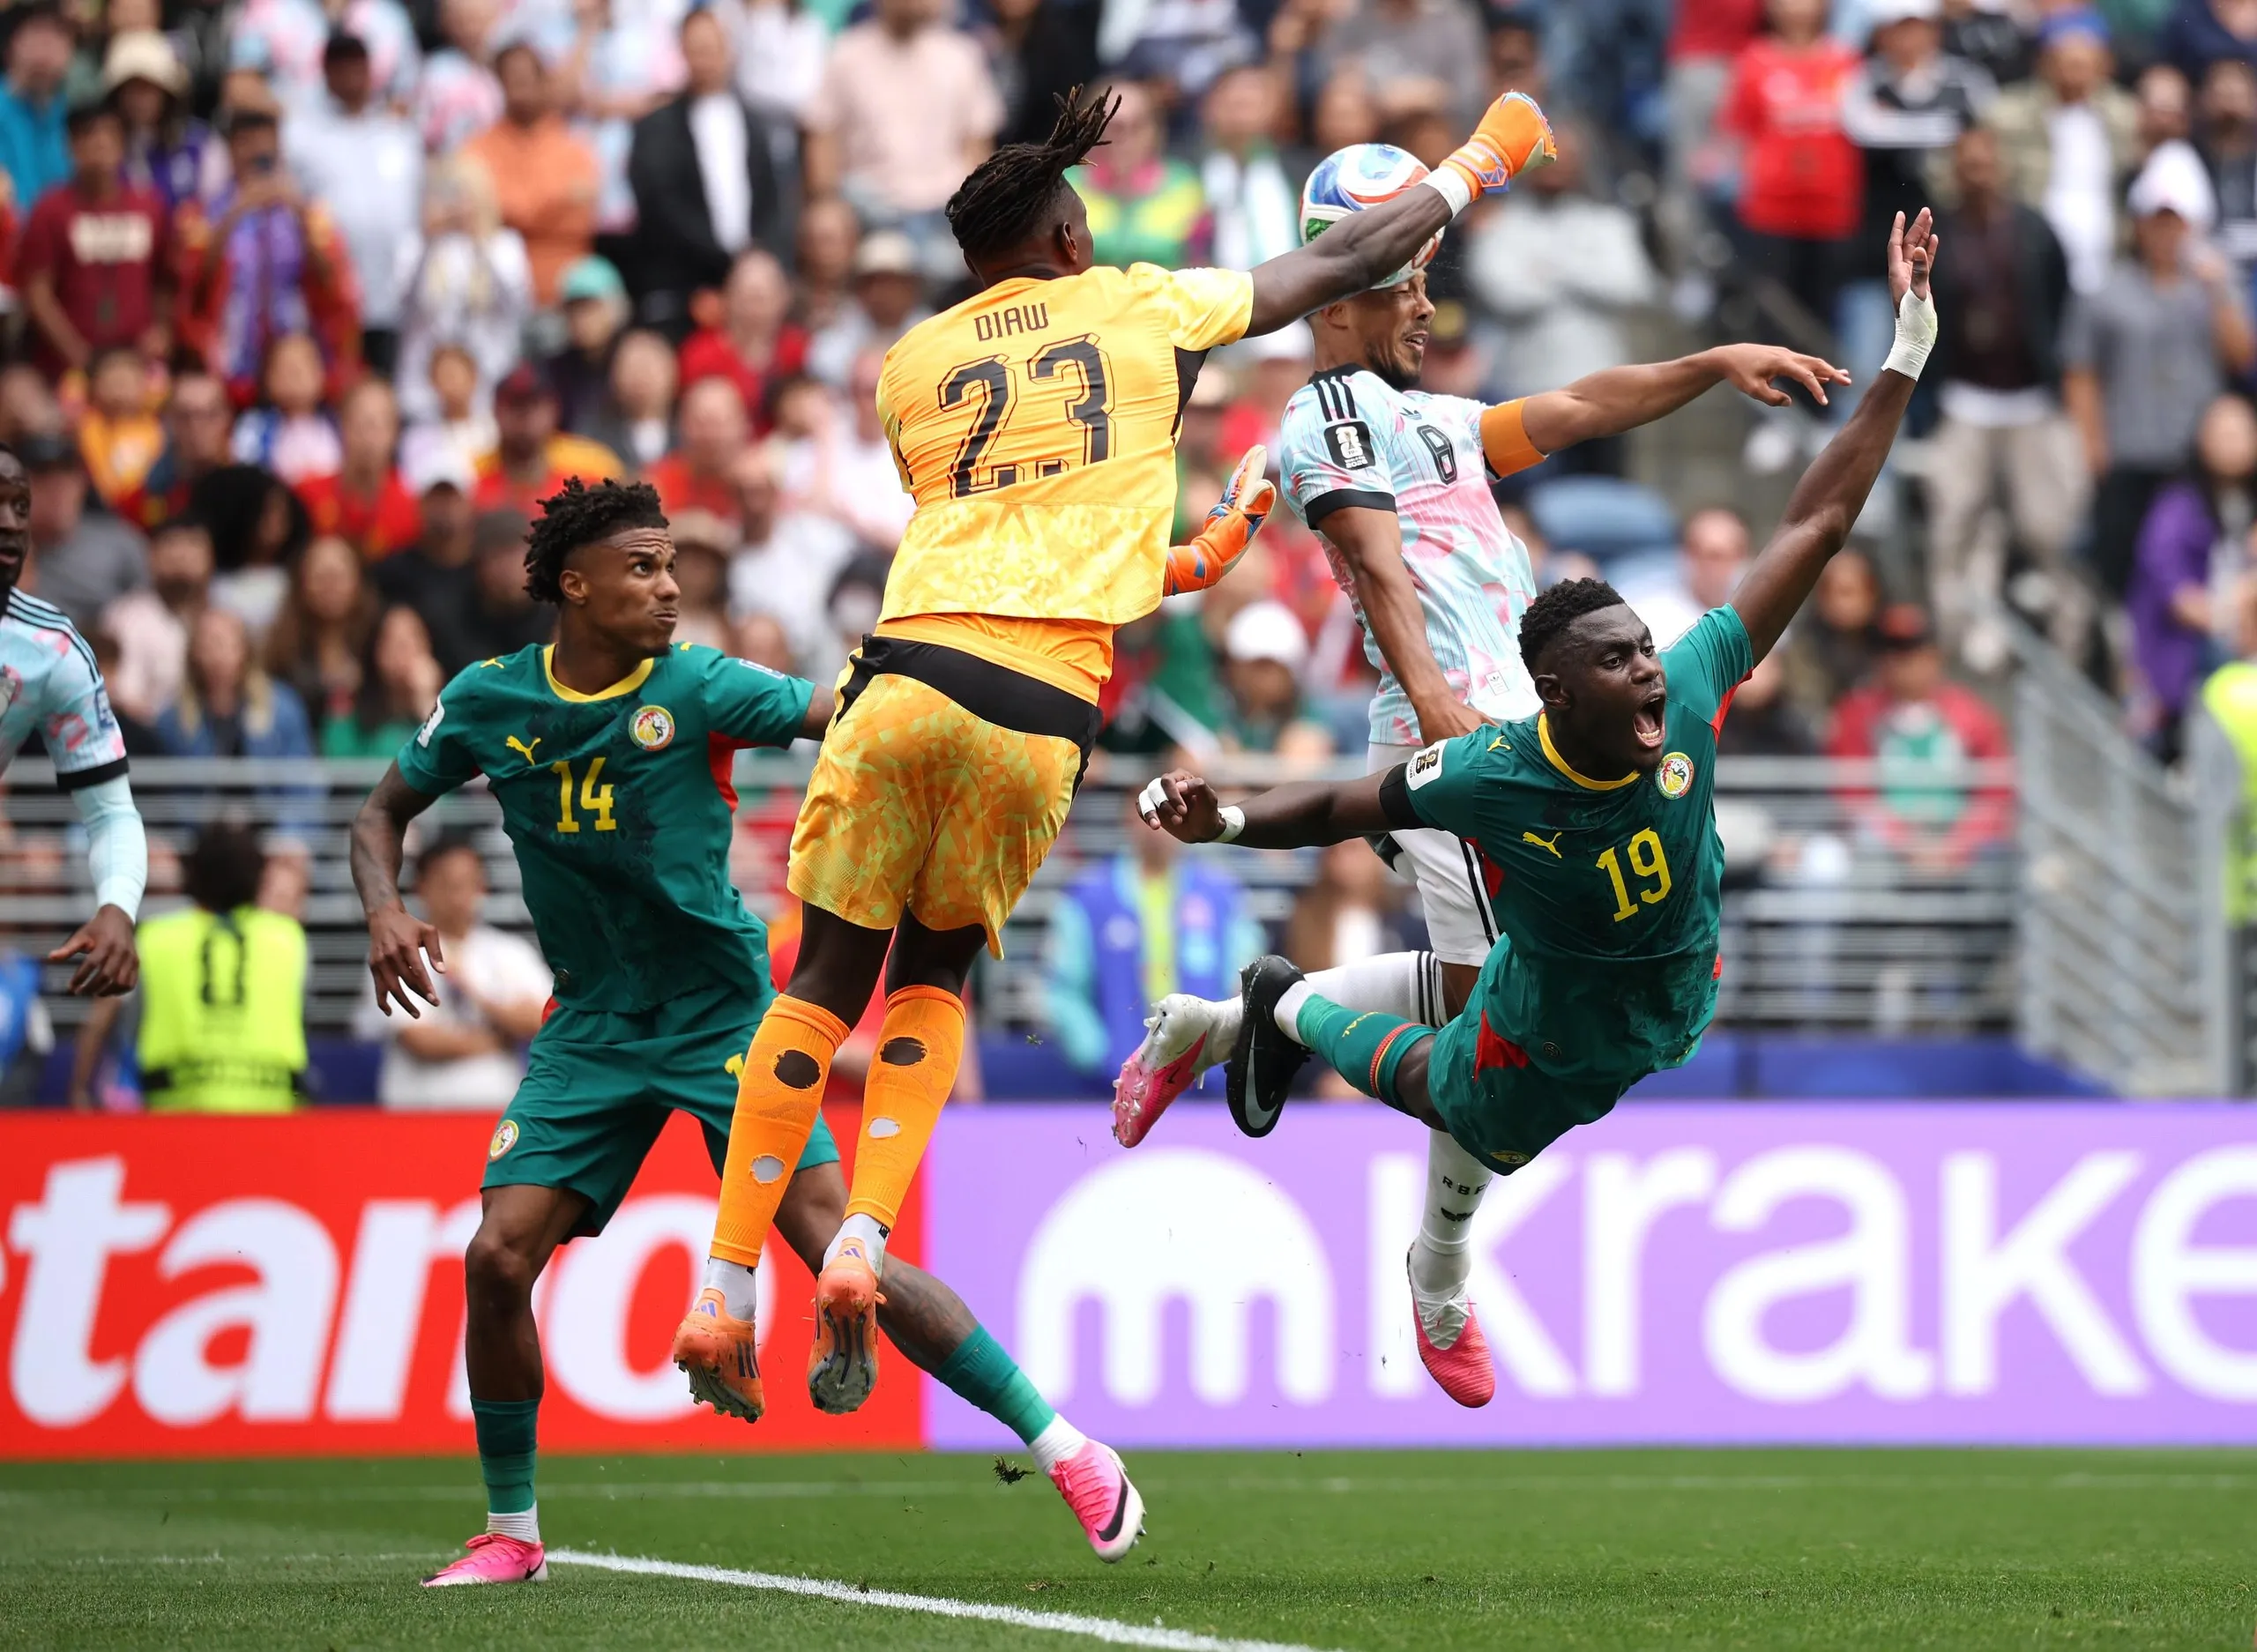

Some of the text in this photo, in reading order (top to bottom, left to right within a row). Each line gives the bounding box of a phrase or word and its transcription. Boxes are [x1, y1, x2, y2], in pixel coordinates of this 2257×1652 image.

[974, 302, 1049, 341] DIAW
[937, 332, 1121, 500] 23
[1416, 424, 1457, 485] 8
[550, 757, 616, 832] 14
[1596, 827, 1672, 922] 19
[1442, 1175, 1493, 1195] RBF
[0, 1154, 775, 1430] tano
